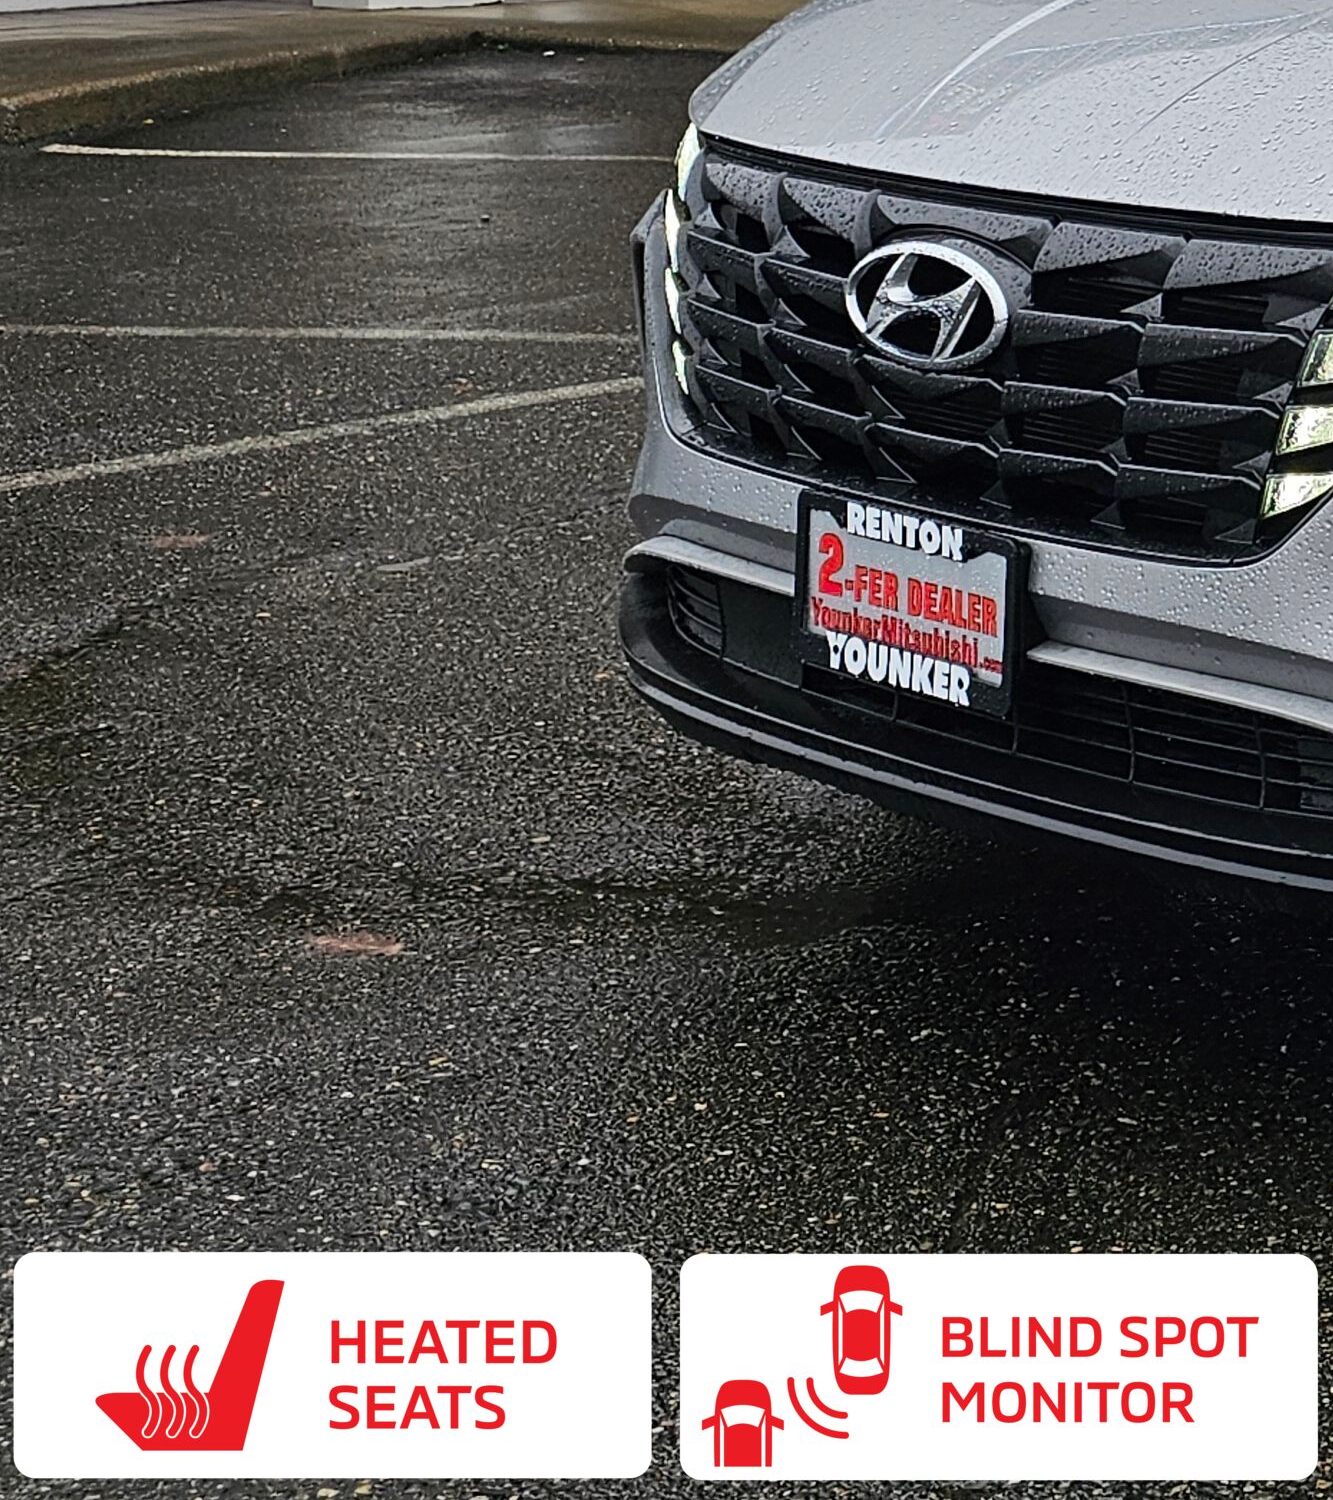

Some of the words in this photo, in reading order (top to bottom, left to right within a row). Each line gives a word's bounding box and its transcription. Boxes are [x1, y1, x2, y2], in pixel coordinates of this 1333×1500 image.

[846, 501, 964, 561] RENTON
[818, 532, 899, 612] 2-FER
[907, 576, 998, 638] DEALER
[826, 630, 971, 706] YOUNKER
